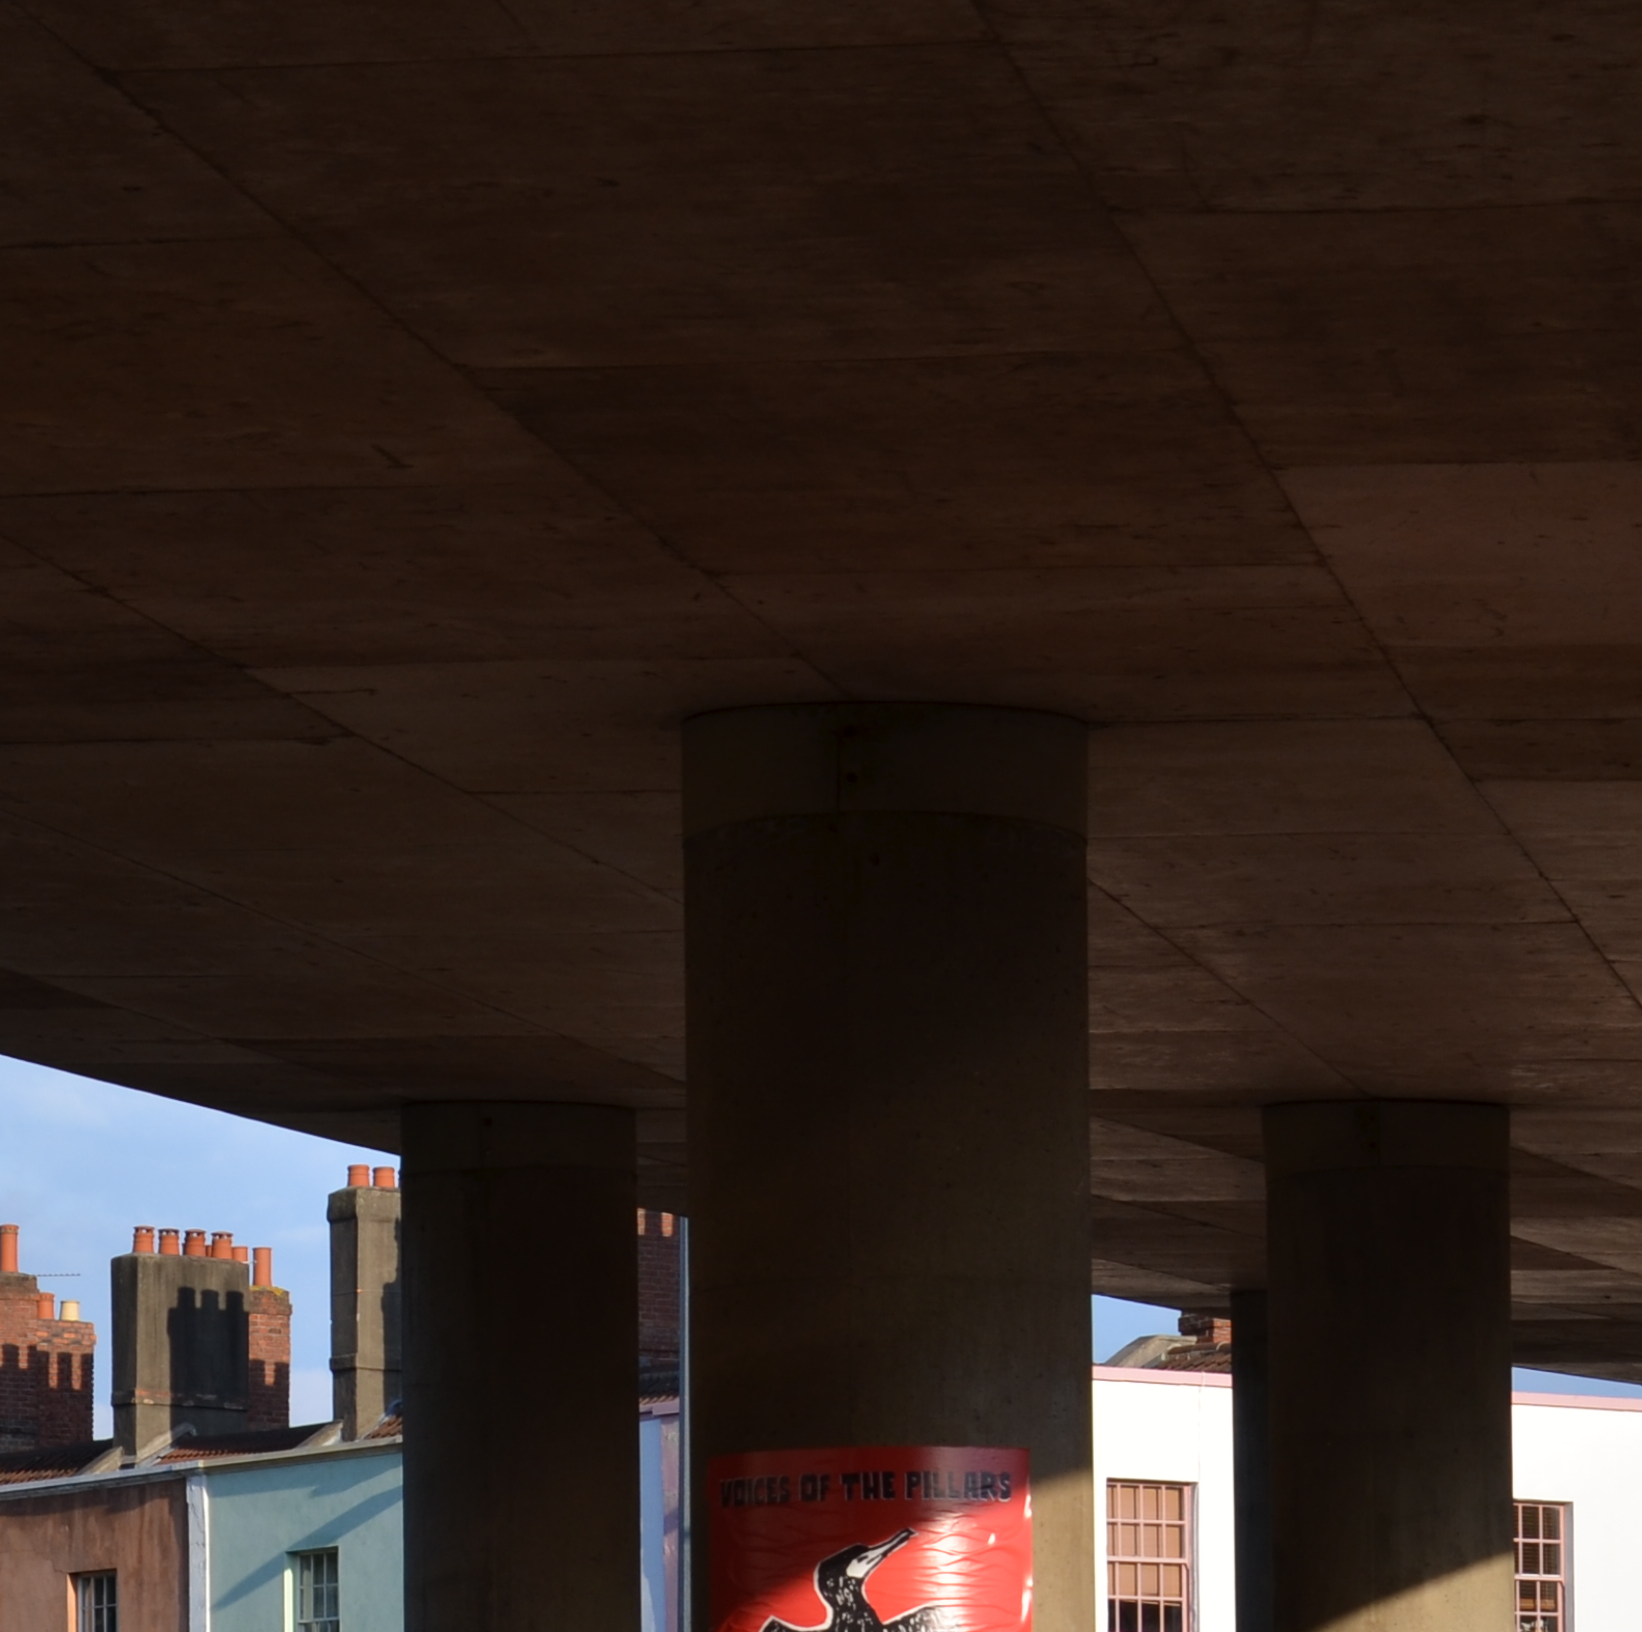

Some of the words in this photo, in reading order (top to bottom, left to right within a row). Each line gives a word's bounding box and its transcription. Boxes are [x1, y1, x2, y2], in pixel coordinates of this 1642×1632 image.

[720, 1475, 791, 1508] VOICES
[799, 1473, 830, 1502] OF
[840, 1472, 895, 1501] THE
[904, 1471, 1012, 1503] PILLARS
